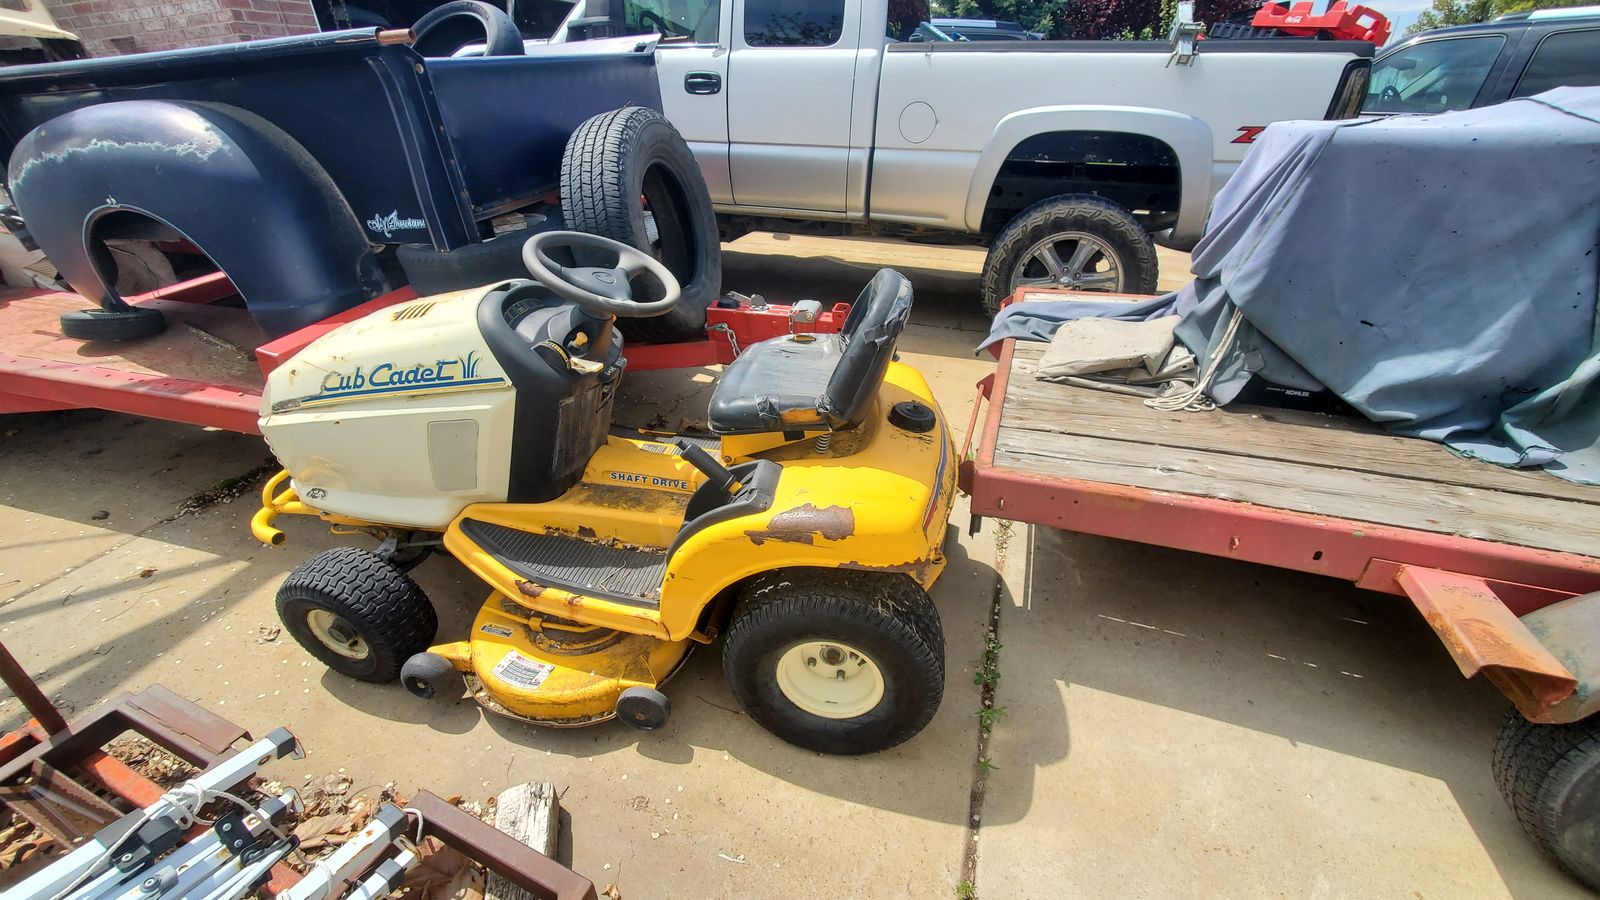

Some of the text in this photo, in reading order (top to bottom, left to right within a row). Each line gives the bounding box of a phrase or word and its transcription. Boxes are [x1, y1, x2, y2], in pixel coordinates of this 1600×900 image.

[321, 359, 459, 391] Cub Cadet
[611, 472, 688, 489] SHAFT DRIVE
